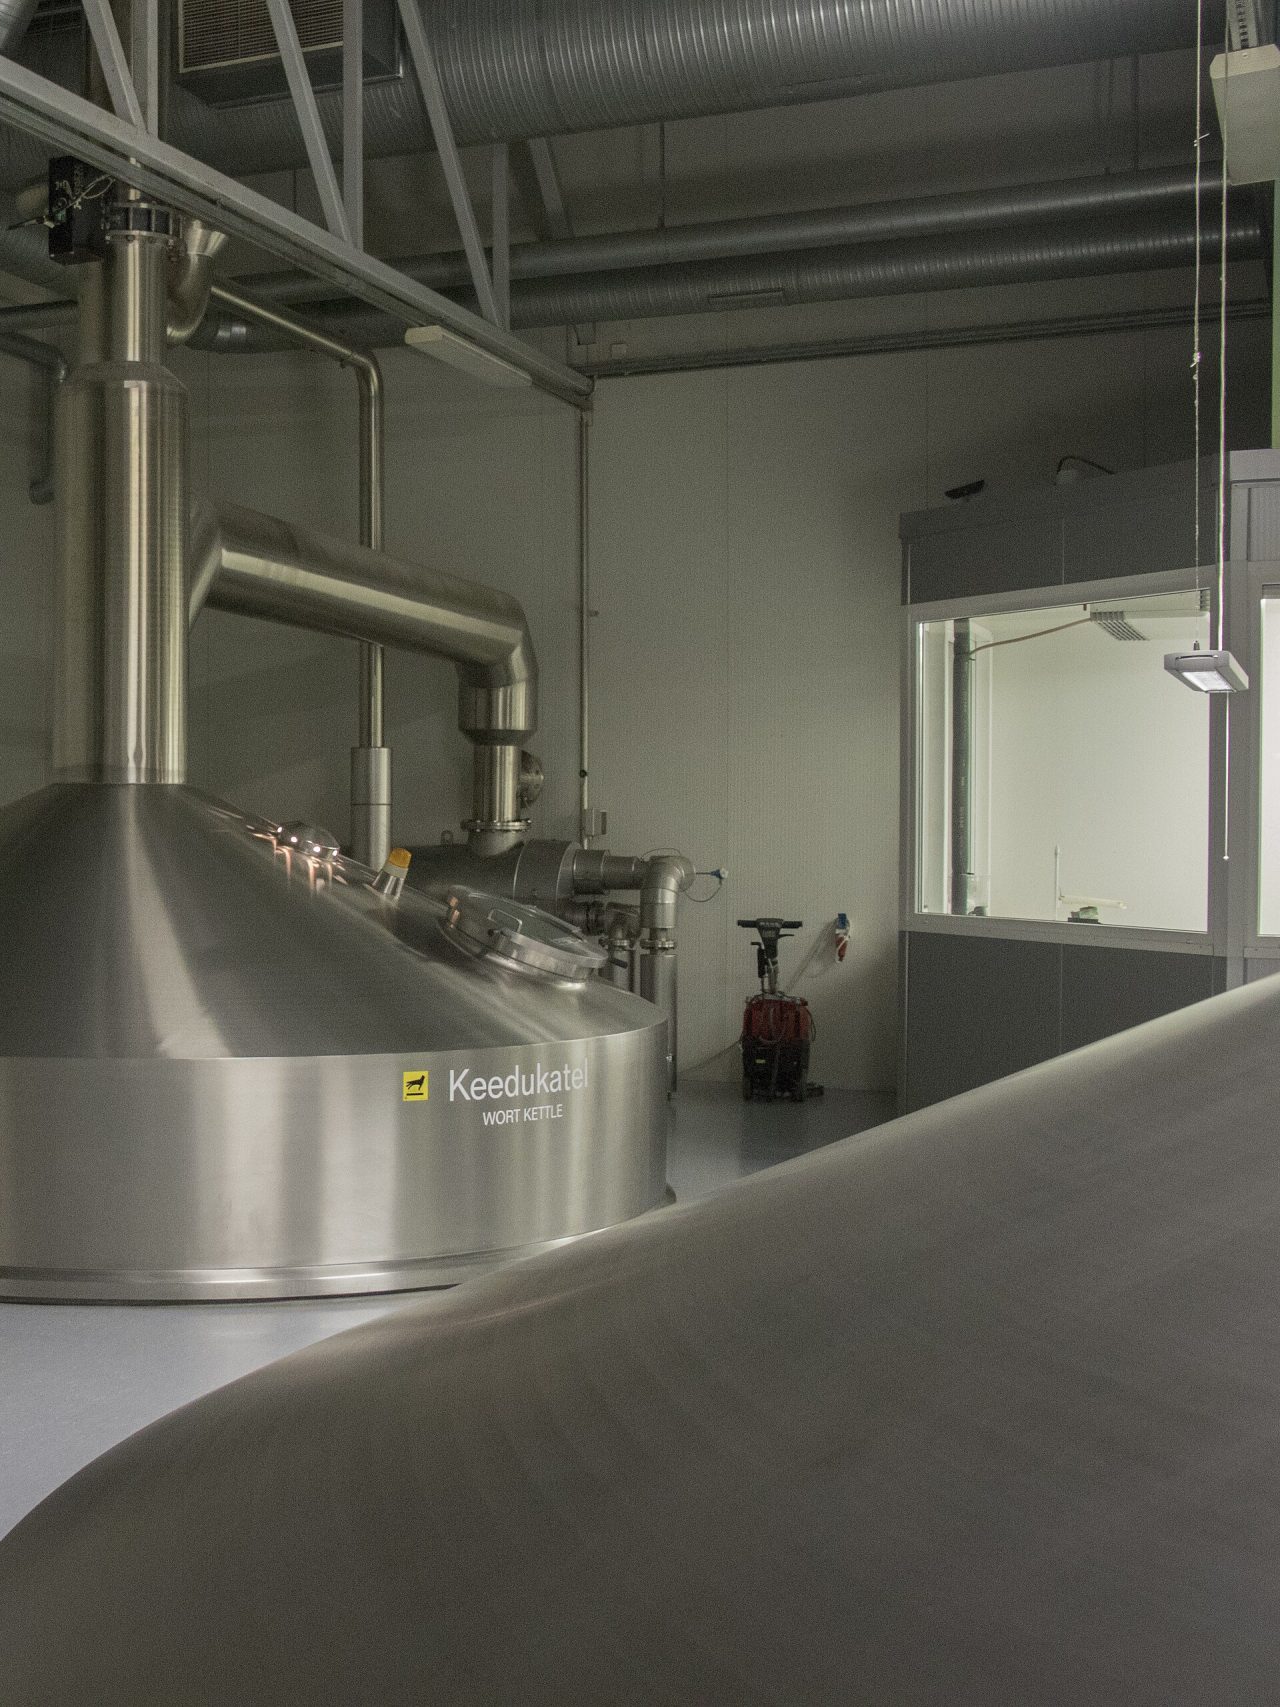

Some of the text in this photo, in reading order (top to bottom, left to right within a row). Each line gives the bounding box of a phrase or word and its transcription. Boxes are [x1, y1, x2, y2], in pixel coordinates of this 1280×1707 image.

[449, 1058, 588, 1102] Keedukatel
[482, 1104, 563, 1126] WORT KETTLE
